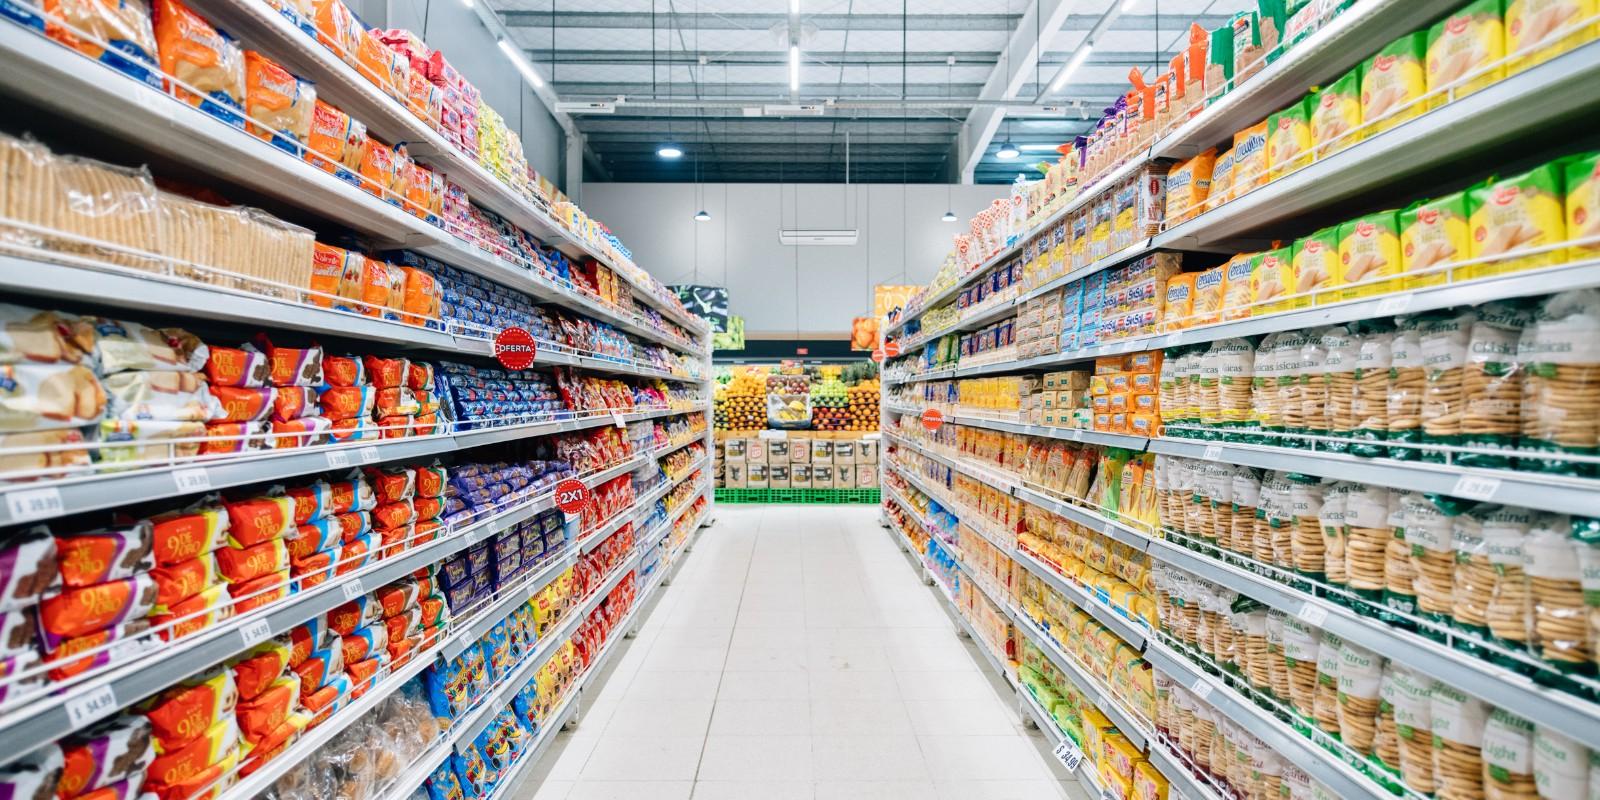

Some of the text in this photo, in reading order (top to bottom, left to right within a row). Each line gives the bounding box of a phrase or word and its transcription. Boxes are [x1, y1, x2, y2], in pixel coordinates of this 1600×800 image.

[500, 344, 531, 352] OFERTA
[561, 489, 583, 504] 2X1
[167, 532, 200, 557] 9 DE ORO
[75, 694, 112, 719] $ 54.99
[1056, 745, 1065, 754] $
